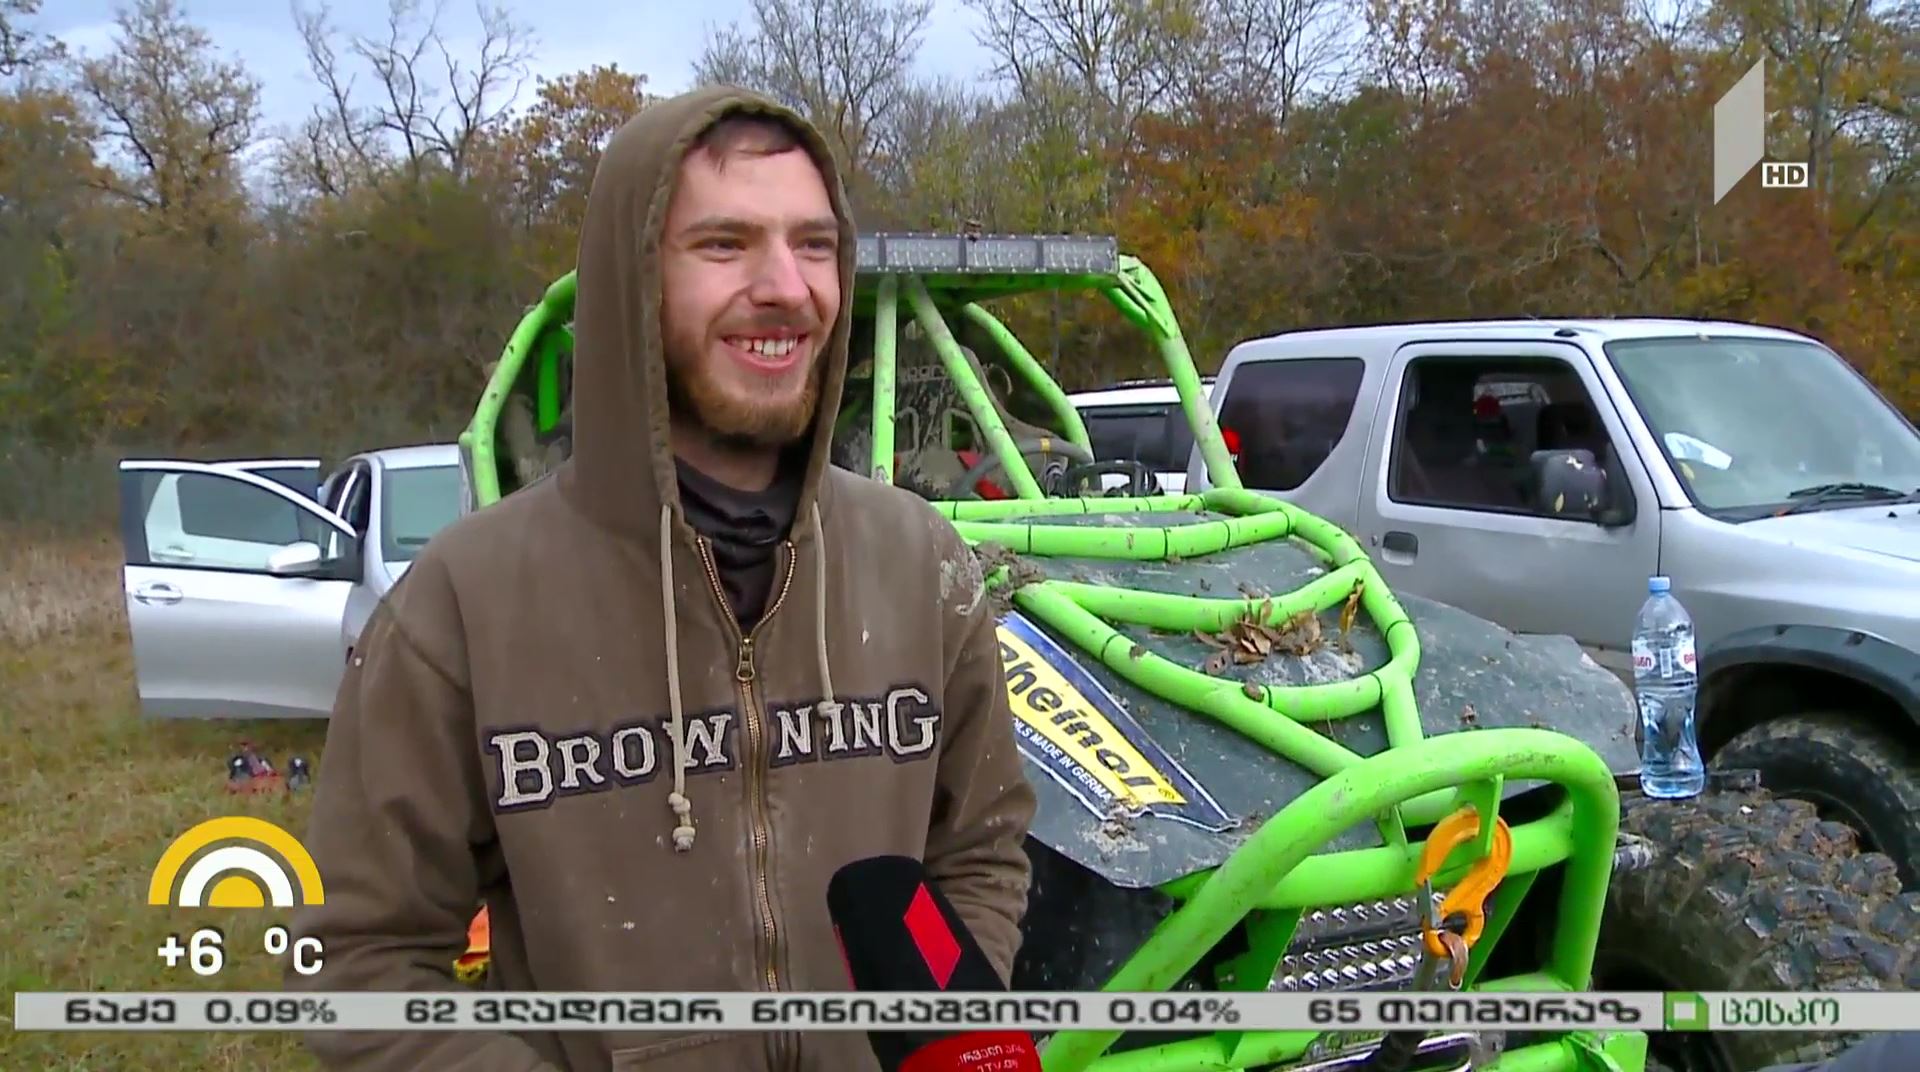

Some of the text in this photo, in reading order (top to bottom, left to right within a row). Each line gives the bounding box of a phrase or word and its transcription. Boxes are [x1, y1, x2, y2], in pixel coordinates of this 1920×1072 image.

[1030, 732, 1063, 760] MADE
[1059, 753, 1076, 769] IN
[1071, 765, 1114, 803] GERMA
